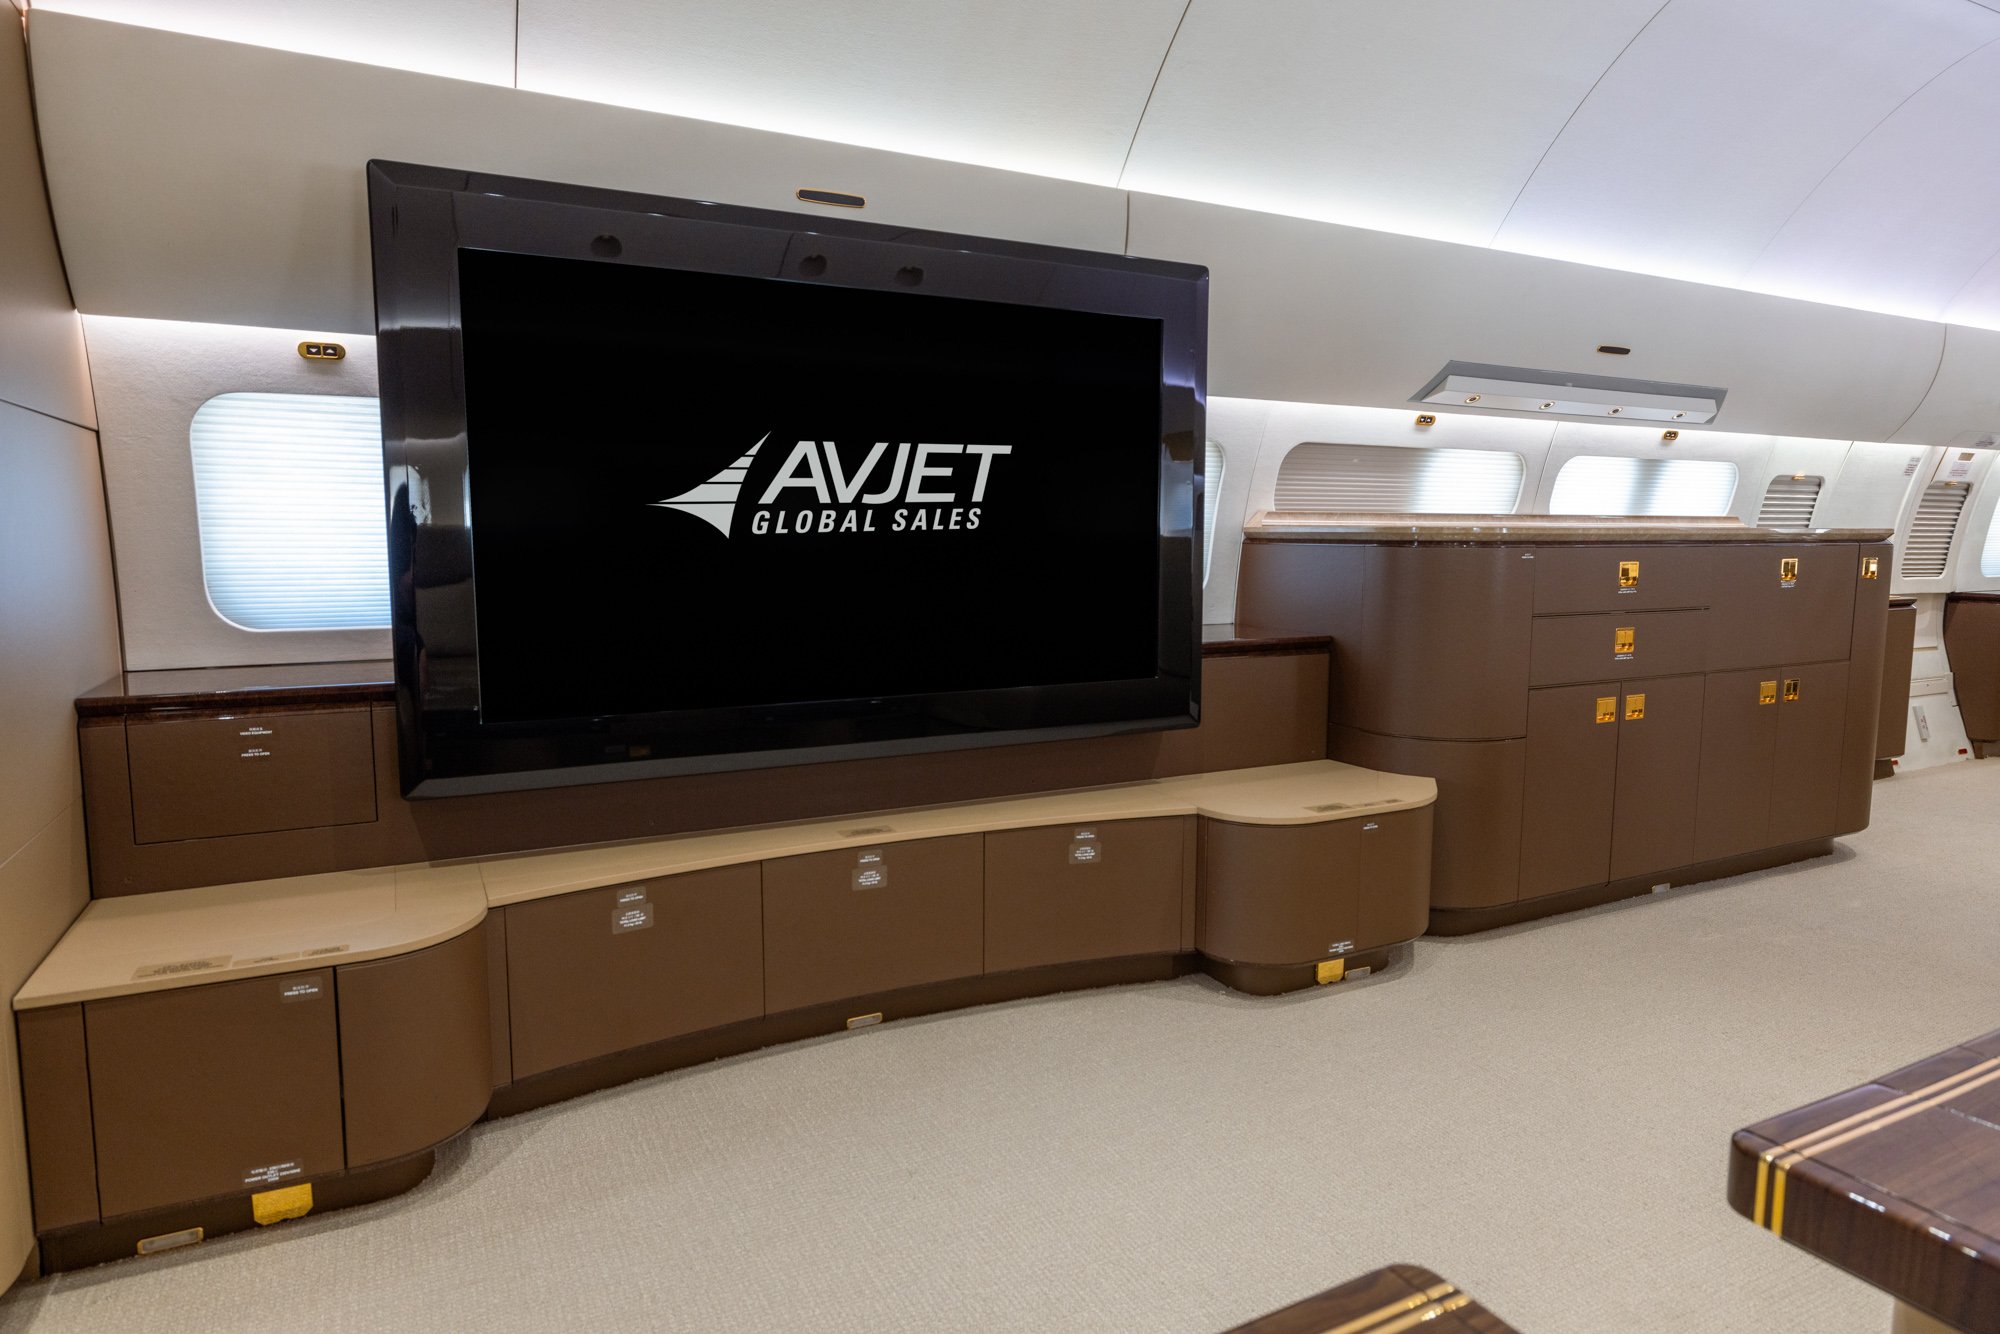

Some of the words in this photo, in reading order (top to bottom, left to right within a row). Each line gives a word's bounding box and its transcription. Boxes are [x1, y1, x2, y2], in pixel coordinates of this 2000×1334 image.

[758, 441, 1012, 504] AVJET
[752, 510, 876, 535] GLOBAL
[892, 507, 982, 531] SALES
